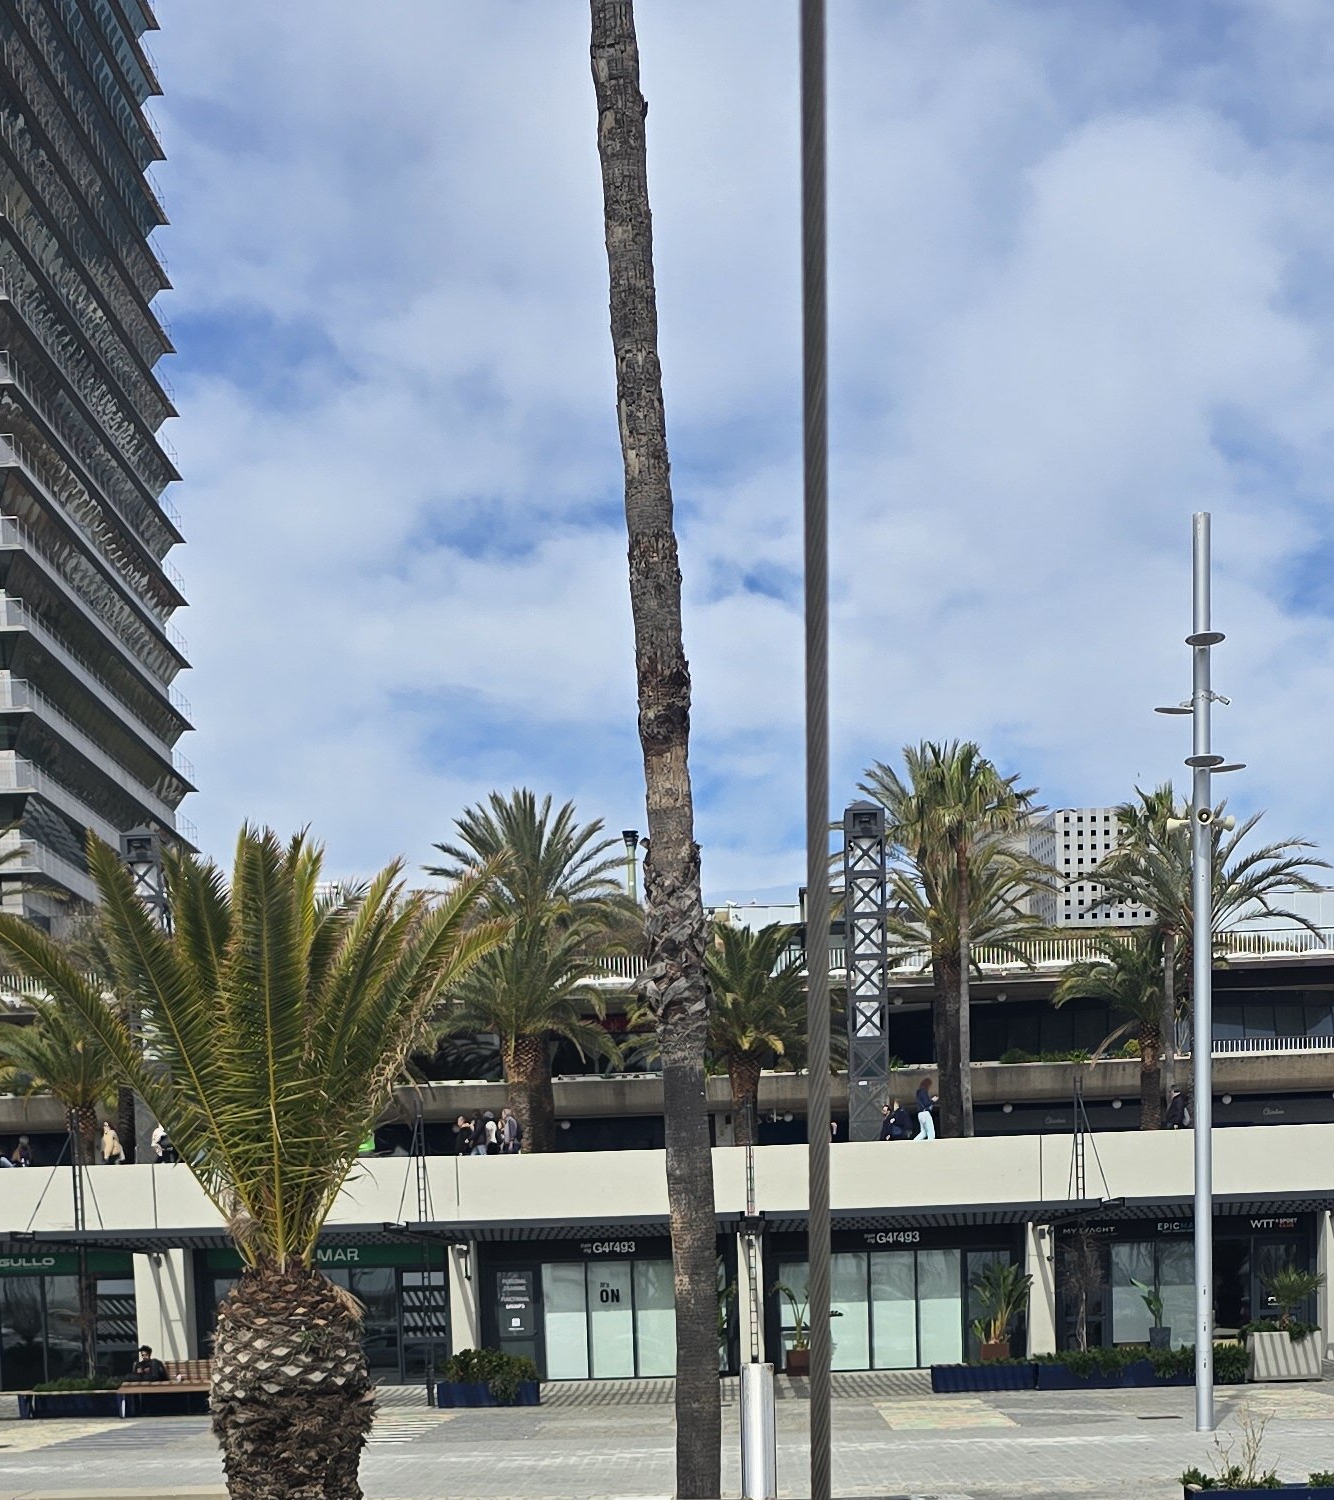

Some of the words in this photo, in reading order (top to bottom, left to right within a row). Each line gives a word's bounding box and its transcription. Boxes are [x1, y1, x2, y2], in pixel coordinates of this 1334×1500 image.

[876, 1231, 920, 1244] G4r4g3
[592, 1241, 636, 1253] G4r4g3
[599, 1288, 621, 1304] ON
